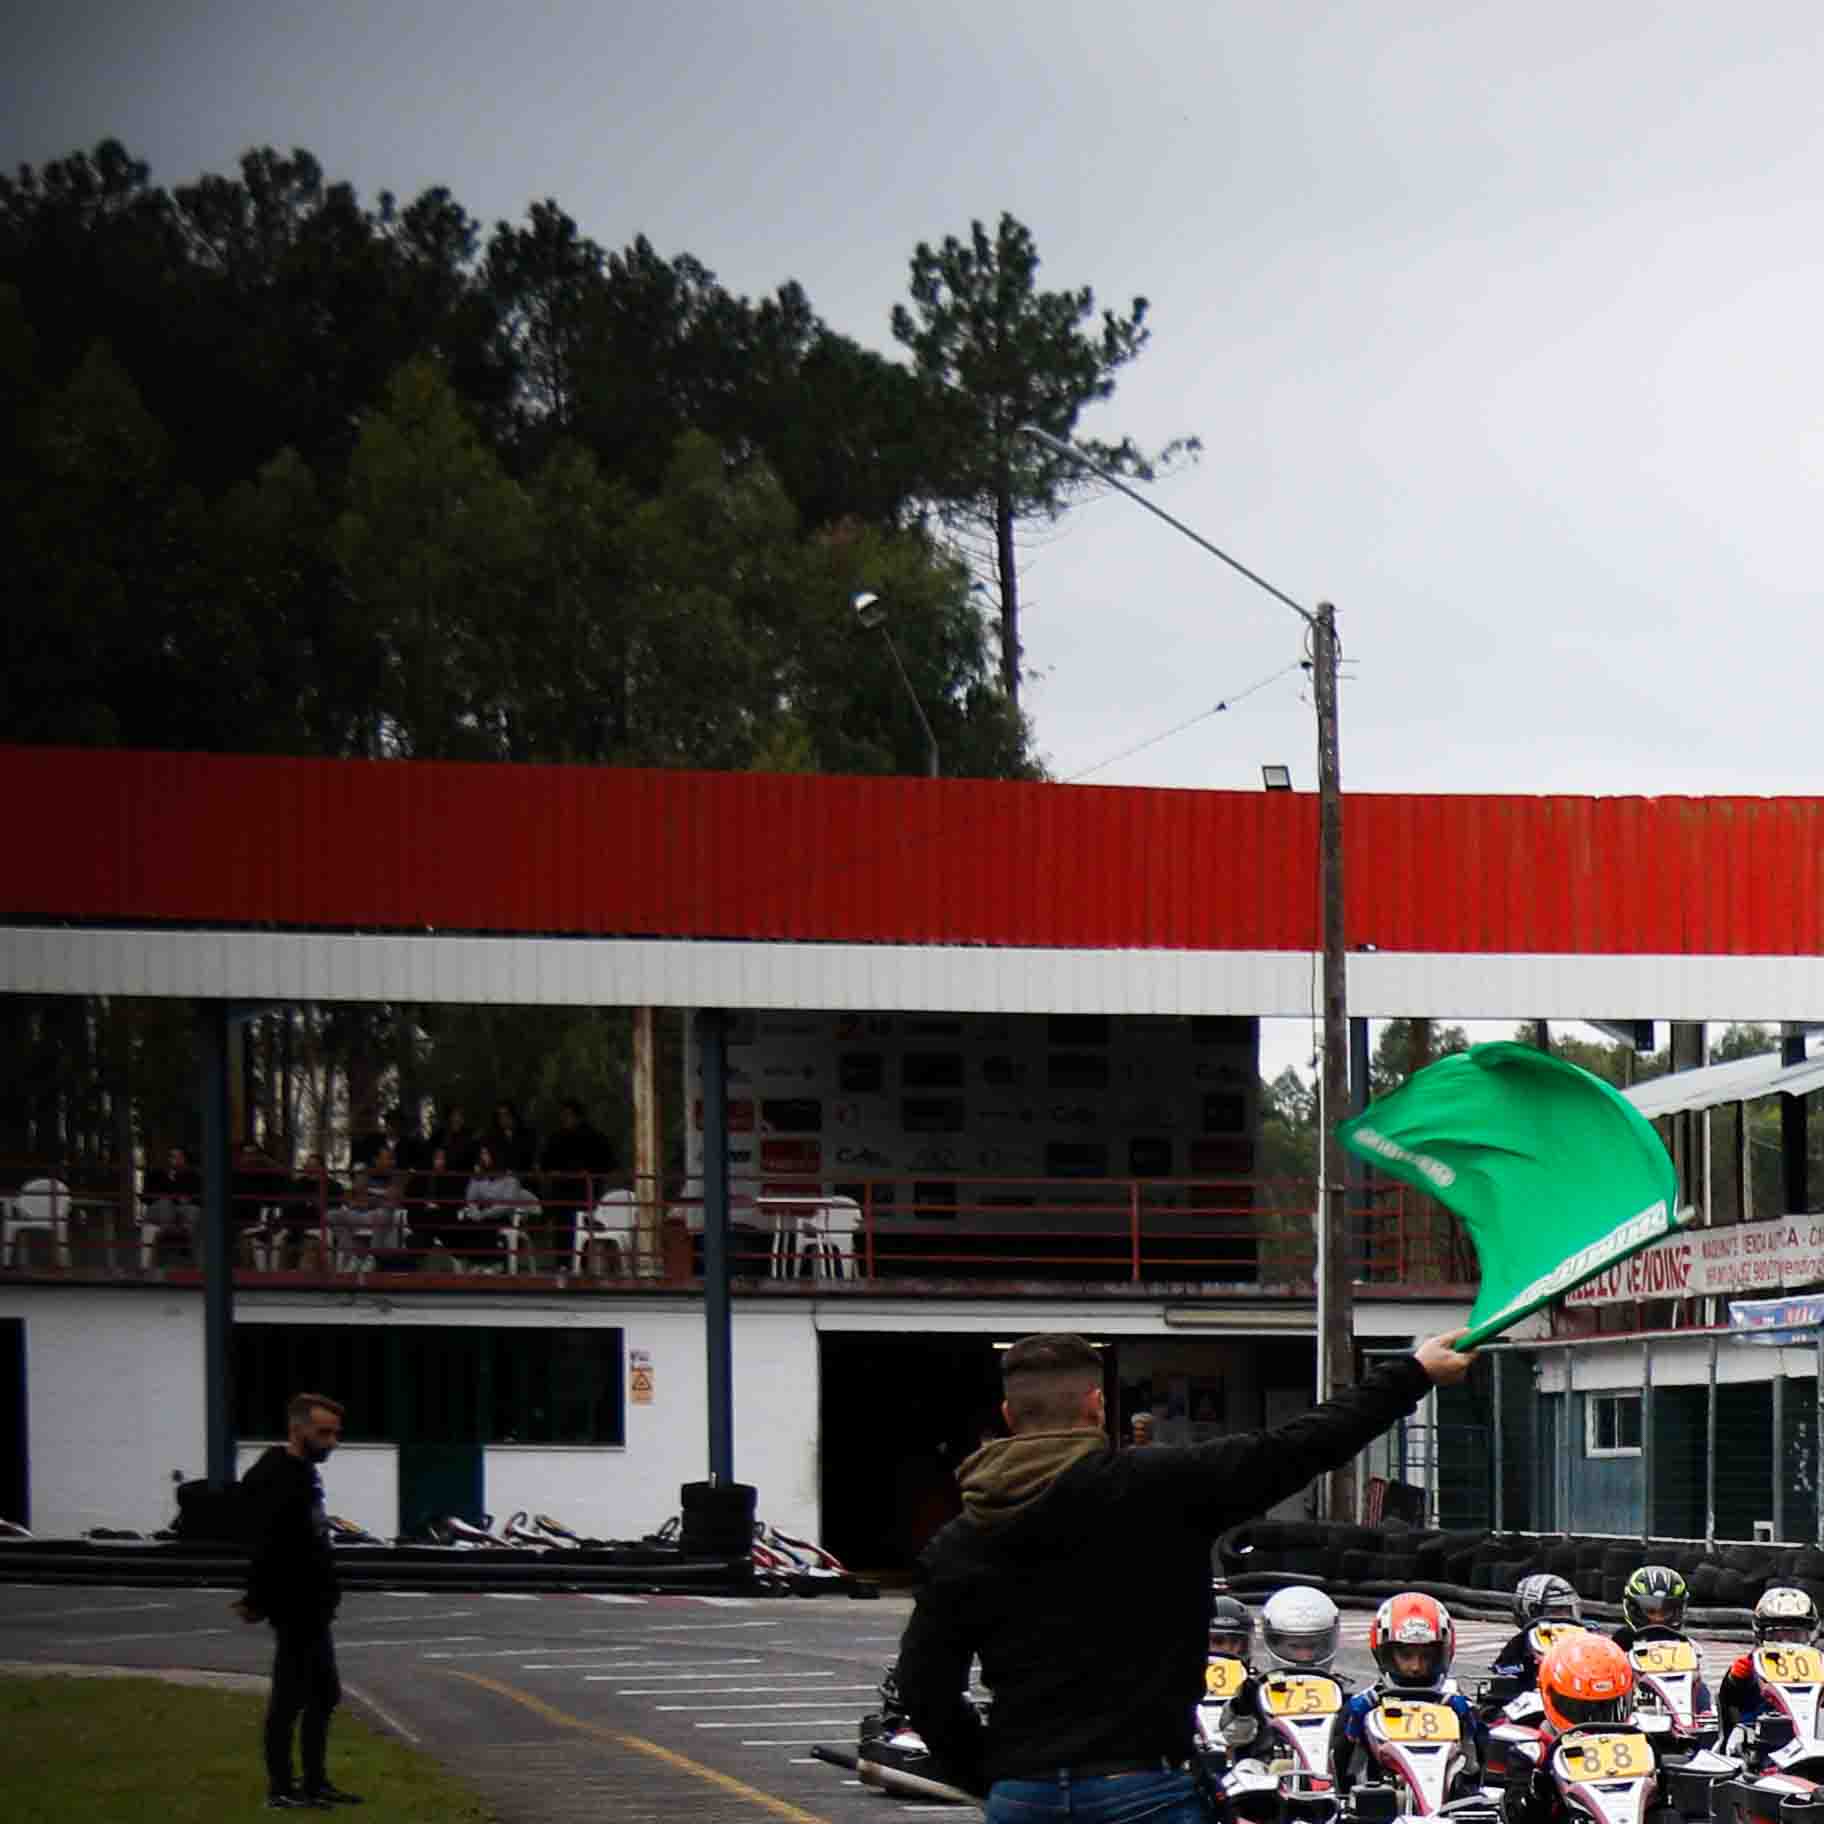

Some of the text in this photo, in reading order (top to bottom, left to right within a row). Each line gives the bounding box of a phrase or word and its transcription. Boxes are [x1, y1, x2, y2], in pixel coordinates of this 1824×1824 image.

[1649, 1646, 1679, 1666] 67
[1775, 1655, 1810, 1678] 80
[1284, 1687, 1322, 1711] 75
[1401, 1711, 1439, 1735] 78
[1583, 1742, 1633, 1773] 88
